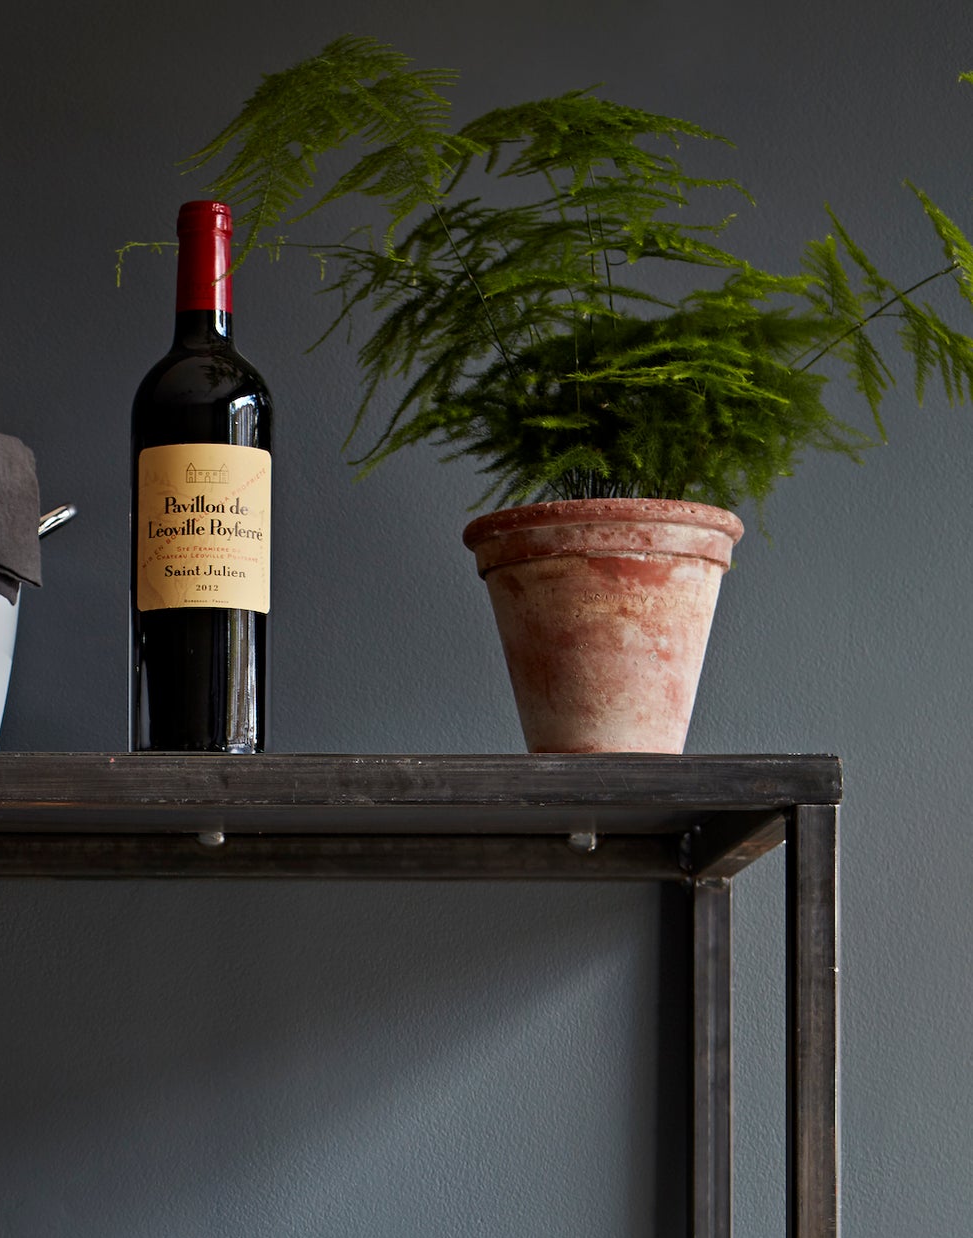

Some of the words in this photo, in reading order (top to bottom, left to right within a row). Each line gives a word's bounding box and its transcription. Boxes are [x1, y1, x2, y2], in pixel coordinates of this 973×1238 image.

[164, 495, 225, 514] Pavillon
[230, 497, 249, 516] de
[148, 518, 205, 539] Léoville
[209, 518, 263, 541] Poyferré
[164, 565, 201, 579] Saint
[203, 565, 246, 579] Julien
[196, 584, 219, 592] 2012
